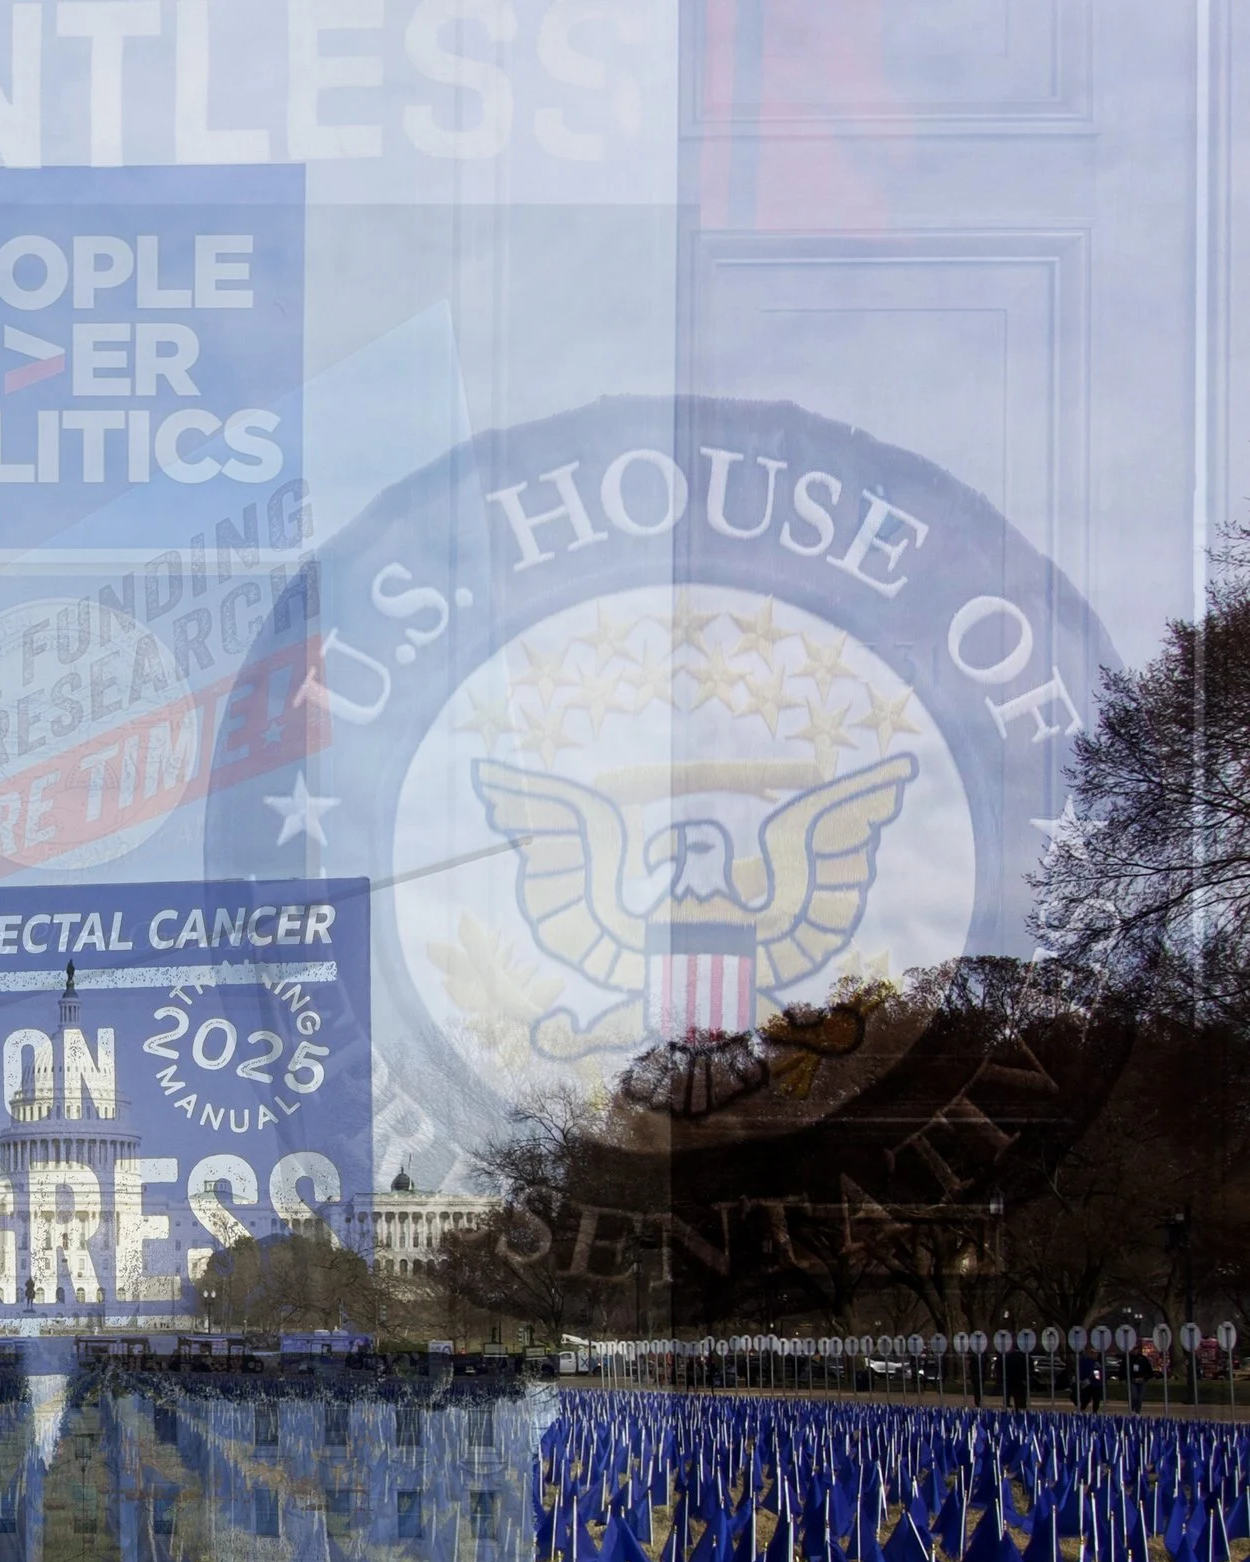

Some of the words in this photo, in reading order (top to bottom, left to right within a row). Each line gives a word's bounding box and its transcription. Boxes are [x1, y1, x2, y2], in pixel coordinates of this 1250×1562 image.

[21, 480, 315, 687] FUNDING
[293, 561, 472, 728] U.S.
[488, 444, 930, 601] HOUSE
[947, 594, 1085, 746] OF
[79, 660, 304, 825] TIME!
[147, 904, 337, 952] CANCER
[2, 1027, 115, 1123] ON
[142, 1006, 327, 1095] 2025
[155, 1064, 301, 1133] MANUAL
